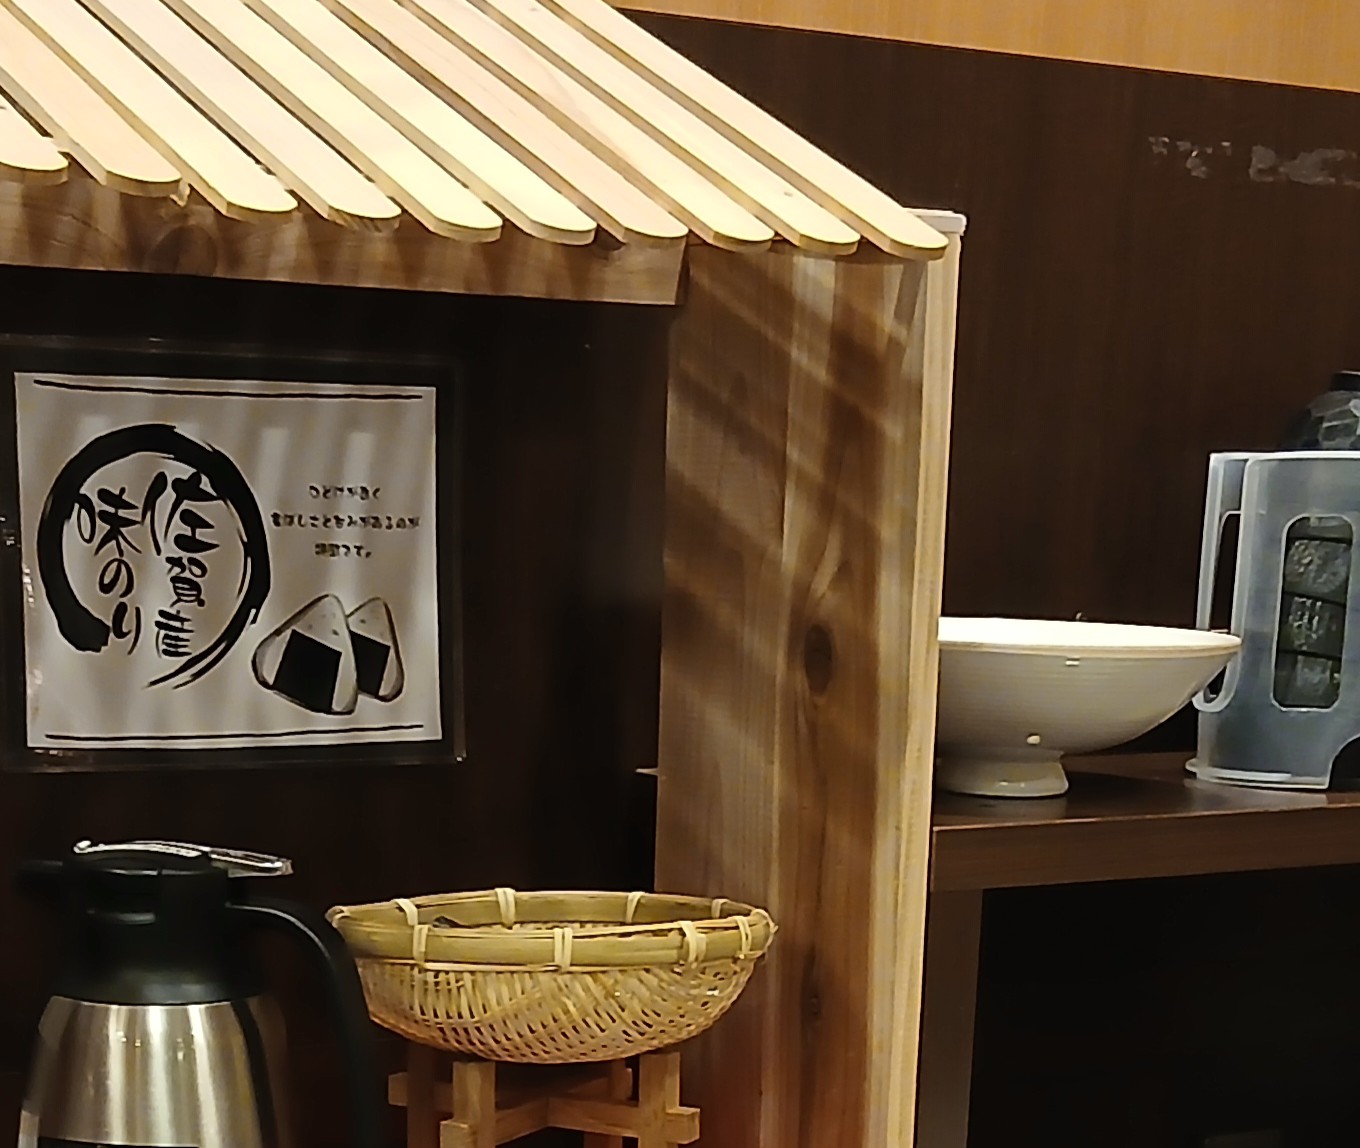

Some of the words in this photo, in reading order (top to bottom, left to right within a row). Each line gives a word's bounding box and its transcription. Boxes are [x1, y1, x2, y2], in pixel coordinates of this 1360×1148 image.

[74, 486, 144, 656] 味のり
[143, 470, 222, 659] 佐賀産
